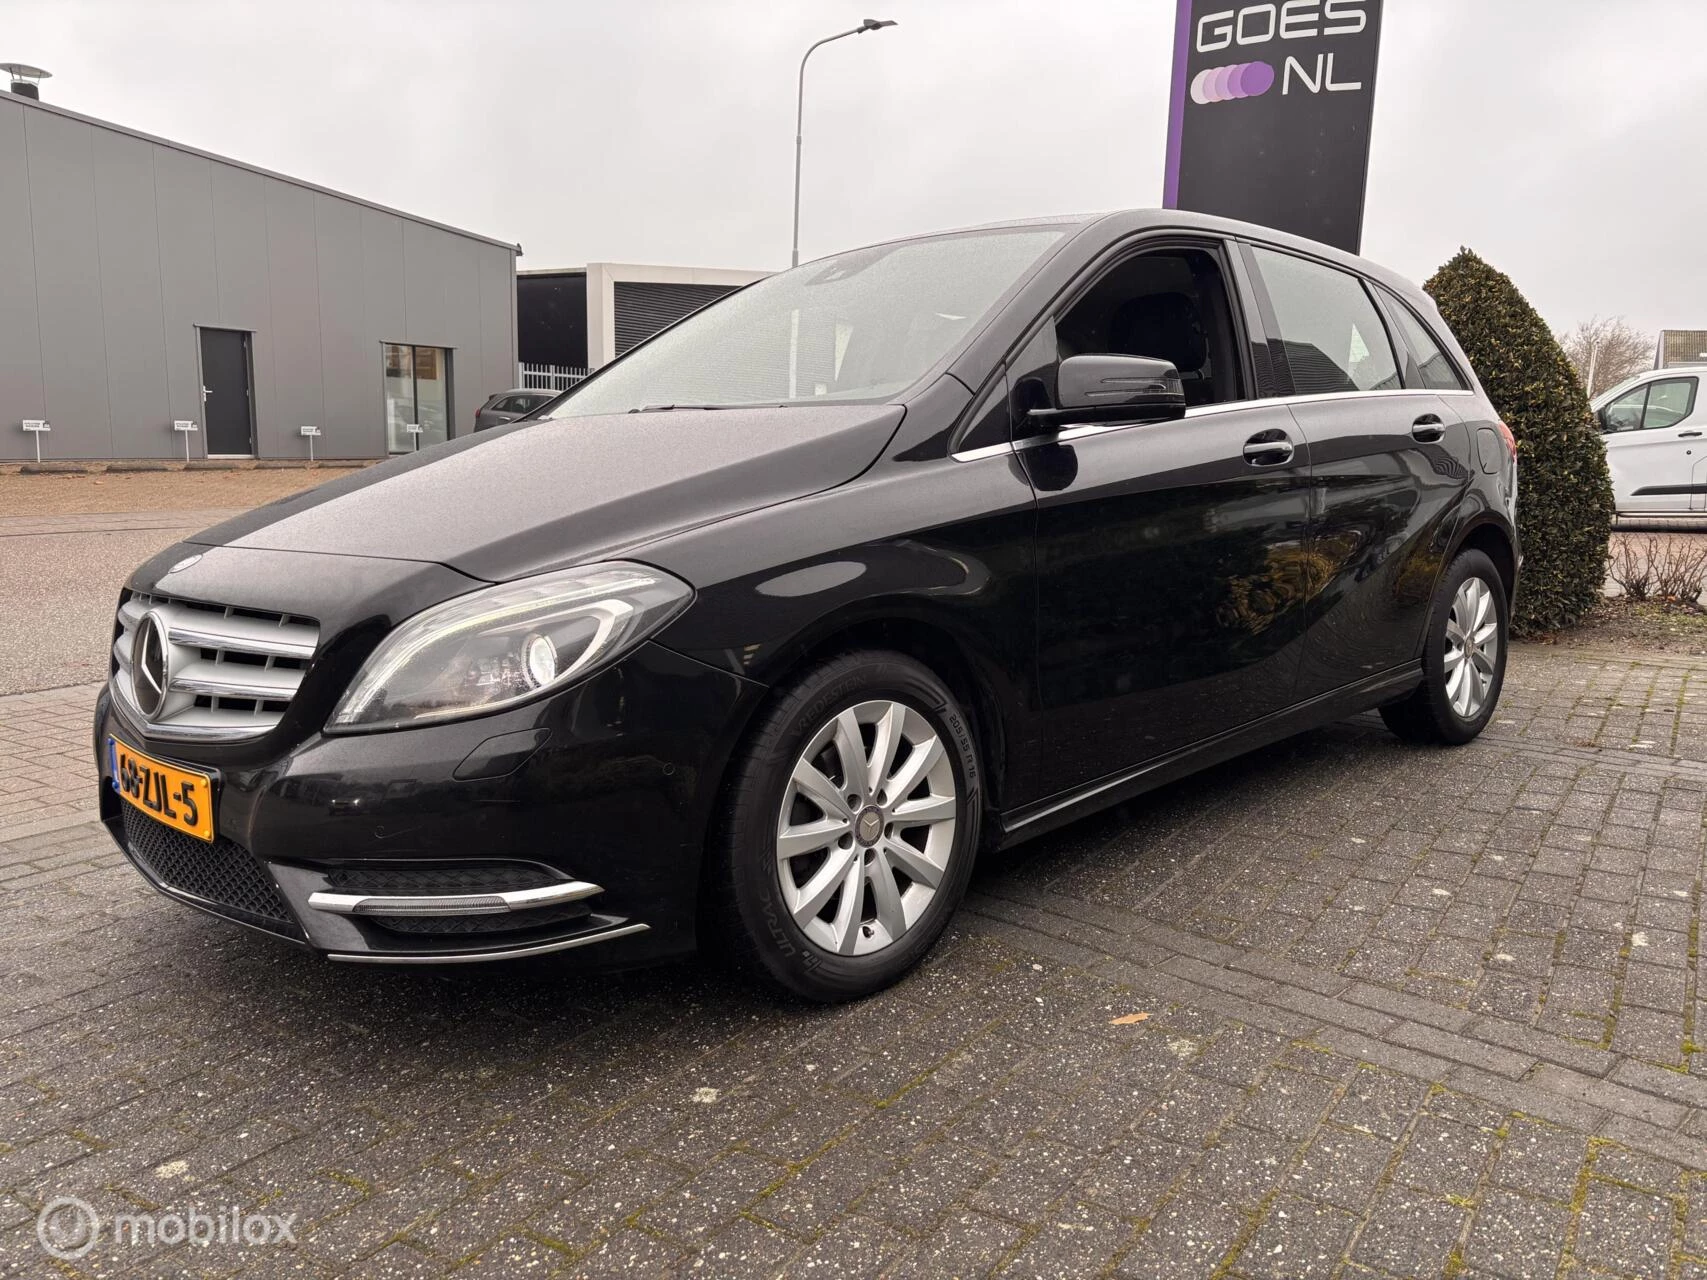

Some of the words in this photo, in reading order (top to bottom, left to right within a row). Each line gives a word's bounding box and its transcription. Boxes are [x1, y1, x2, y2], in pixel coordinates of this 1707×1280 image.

[1197, 0, 1367, 53] GOES
[1282, 52, 1362, 95] NL
[949, 714, 971, 752] 205/55
